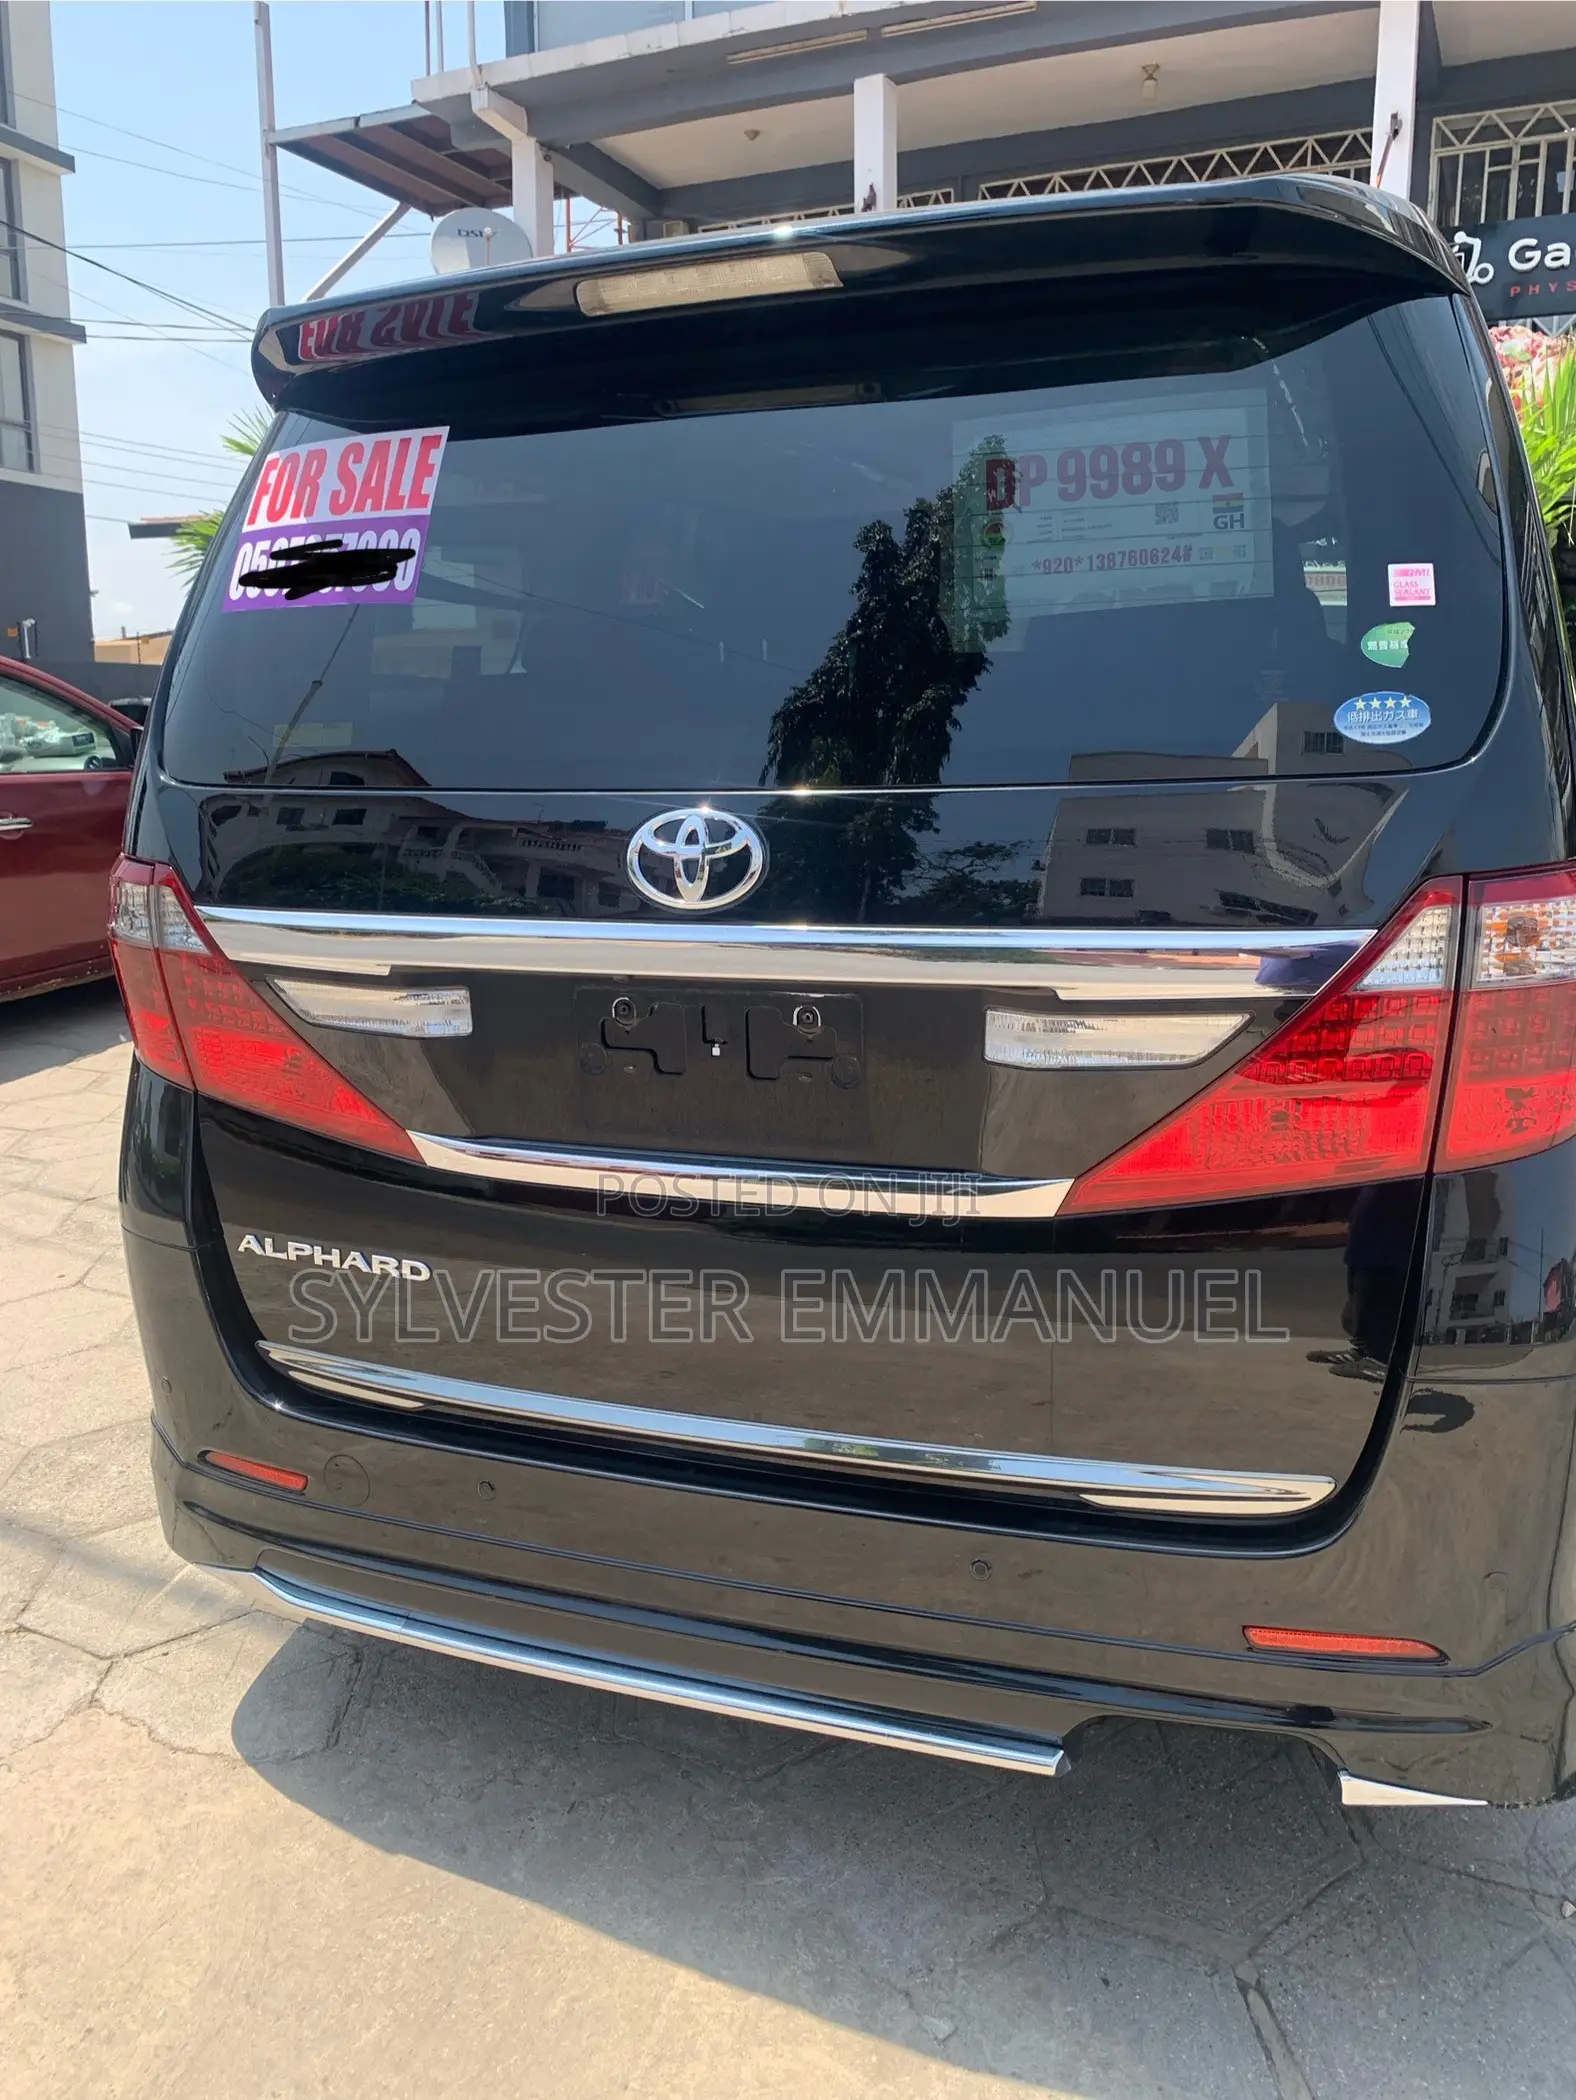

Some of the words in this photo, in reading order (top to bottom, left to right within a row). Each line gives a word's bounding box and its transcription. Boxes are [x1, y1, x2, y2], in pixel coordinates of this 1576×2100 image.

[1508, 238, 1576, 272] Ga
[247, 448, 328, 526] FOR
[328, 435, 443, 517] SALE
[985, 454, 1047, 511] DP
[1057, 438, 1186, 502] 9989
[1196, 435, 1234, 489] X
[1213, 513, 1245, 530] GH
[1394, 588, 1430, 596] SEALANT
[1347, 709, 1420, 723] 低排出ガス車
[237, 1234, 431, 1282] ALPHARD
